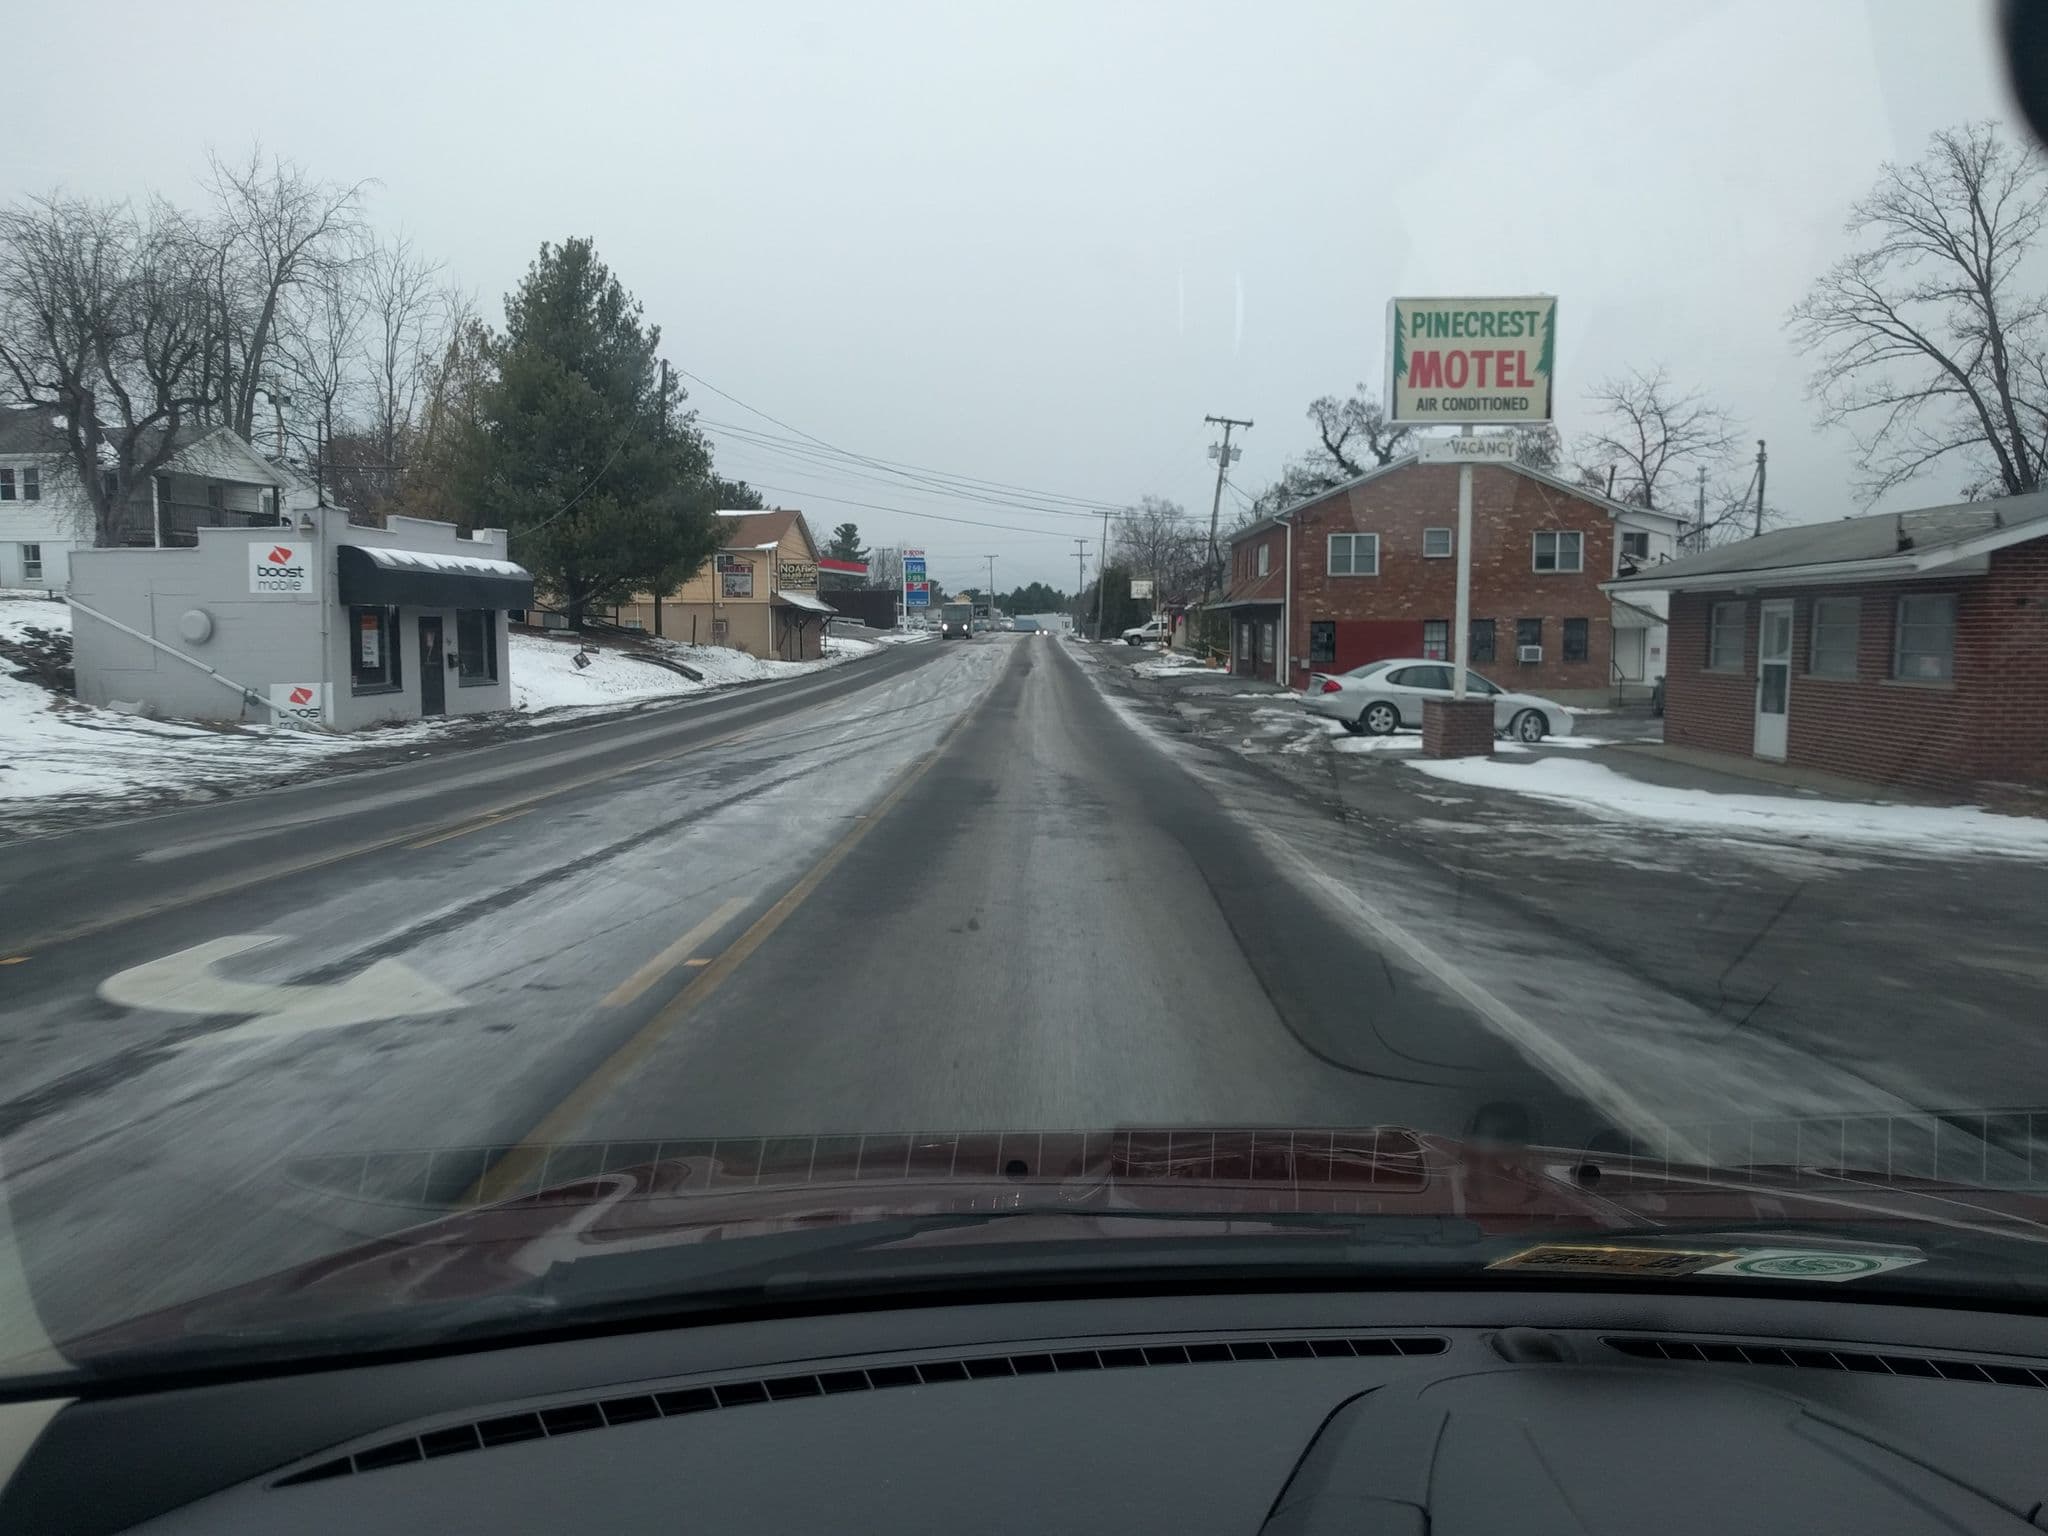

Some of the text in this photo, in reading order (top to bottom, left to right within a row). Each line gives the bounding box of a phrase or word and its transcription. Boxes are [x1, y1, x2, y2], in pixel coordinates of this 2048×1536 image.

[1411, 311, 1540, 338] PINECREST
[1408, 350, 1536, 388] MOTEL
[1416, 397, 1529, 411] AIR CONDITIONED
[1452, 440, 1513, 457] VACANCY
[257, 564, 304, 578] boost
[258, 577, 302, 591] mobile
